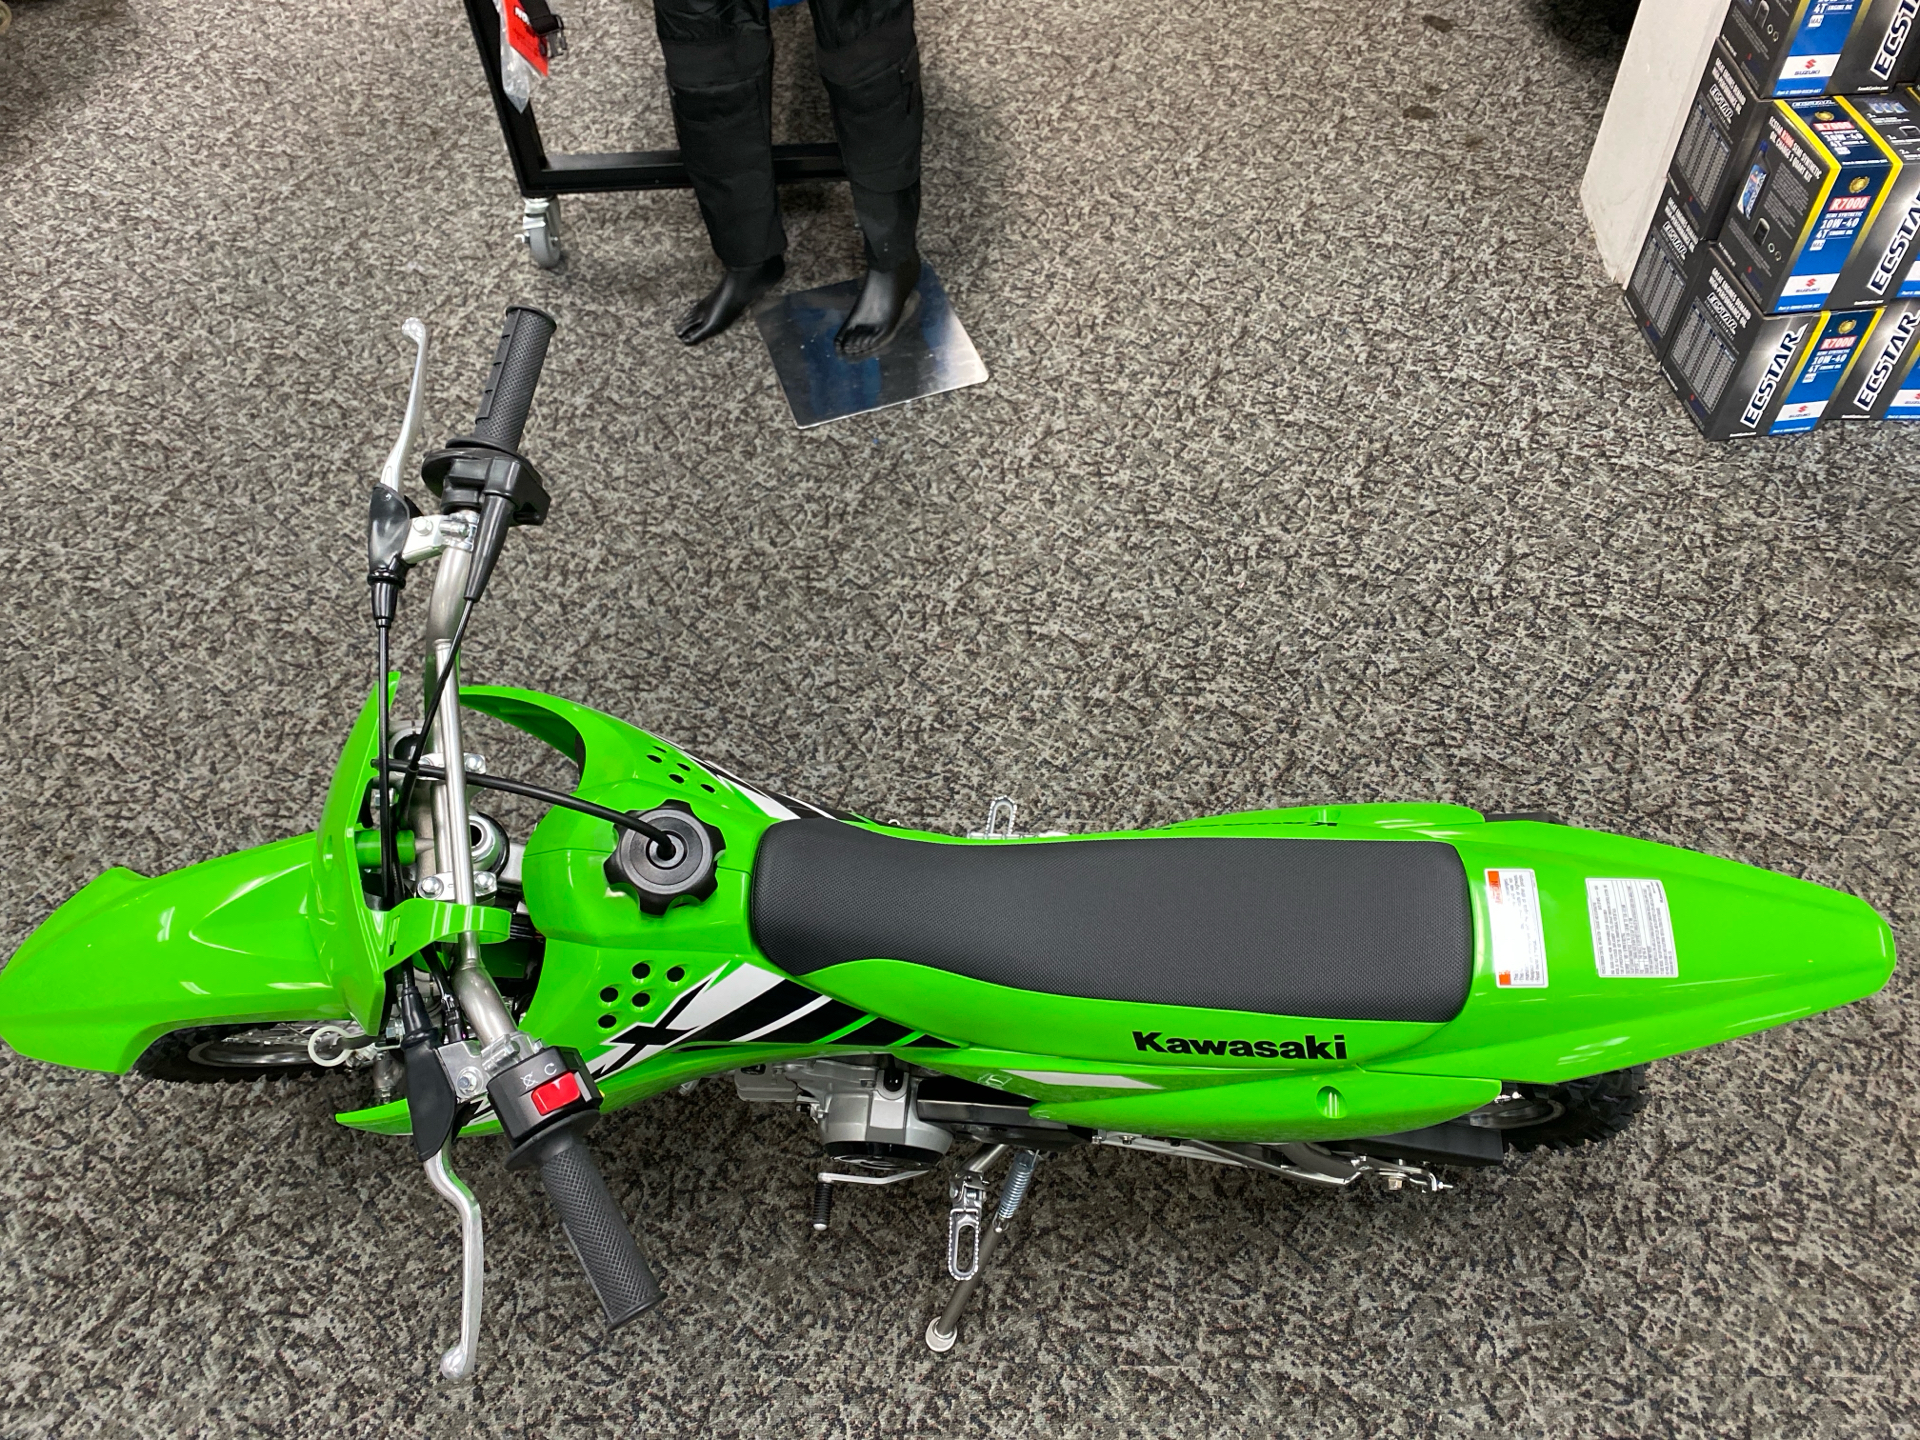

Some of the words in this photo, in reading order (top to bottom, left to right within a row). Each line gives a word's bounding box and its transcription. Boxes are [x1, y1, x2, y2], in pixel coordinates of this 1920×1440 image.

[1870, 0, 1920, 81] ECST
[1709, 83, 1734, 124] ECSTAR
[1829, 196, 1869, 211] R7000
[1815, 229, 1830, 239] 4T
[1820, 217, 1860, 230] 10W-40
[1866, 186, 1920, 296] ECSTA
[1706, 291, 1738, 335] ECSTAR
[1820, 336, 1857, 350] R7000
[1807, 364, 1821, 373] 4T
[1811, 353, 1848, 366] 10W-40
[1853, 310, 1920, 412] ECSTAR
[1740, 322, 1809, 429] ECSTAR
[1132, 1031, 1348, 1060] Kawasaki
